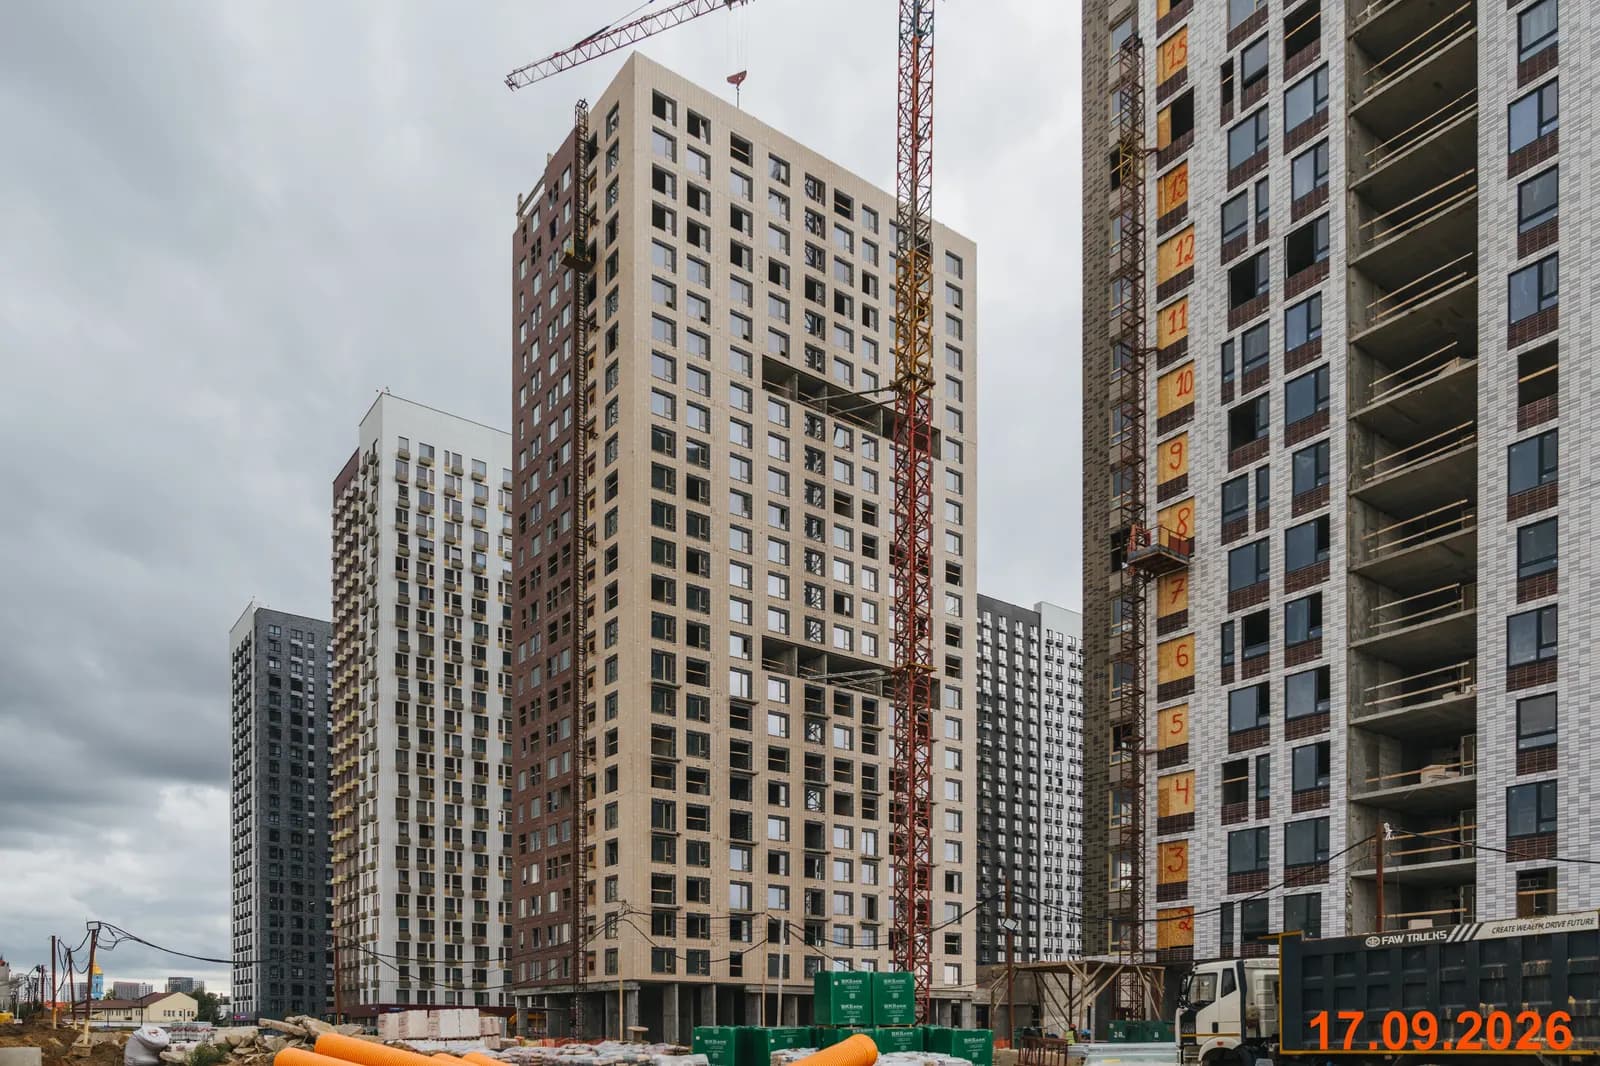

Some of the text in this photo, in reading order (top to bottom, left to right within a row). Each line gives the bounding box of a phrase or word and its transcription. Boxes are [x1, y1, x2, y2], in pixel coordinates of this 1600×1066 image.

[1168, 31, 1188, 70] 15
[1169, 171, 1188, 204] 13
[1175, 234, 1194, 268] 12
[1168, 303, 1187, 335] 11
[1176, 369, 1193, 397] 10
[1169, 441, 1184, 471] 9
[1177, 507, 1191, 536] 8
[1170, 578, 1185, 604] 7
[1176, 644, 1189, 668] 6
[1170, 713, 1183, 735] 5
[1175, 777, 1190, 805] 4
[1168, 846, 1185, 873] 3
[1177, 908, 1193, 931] 2
[1491, 924, 1516, 934] CREATE
[1566, 917, 1595, 927] FUTURE
[1381, 930, 1447, 945] FAW TRUCKS
